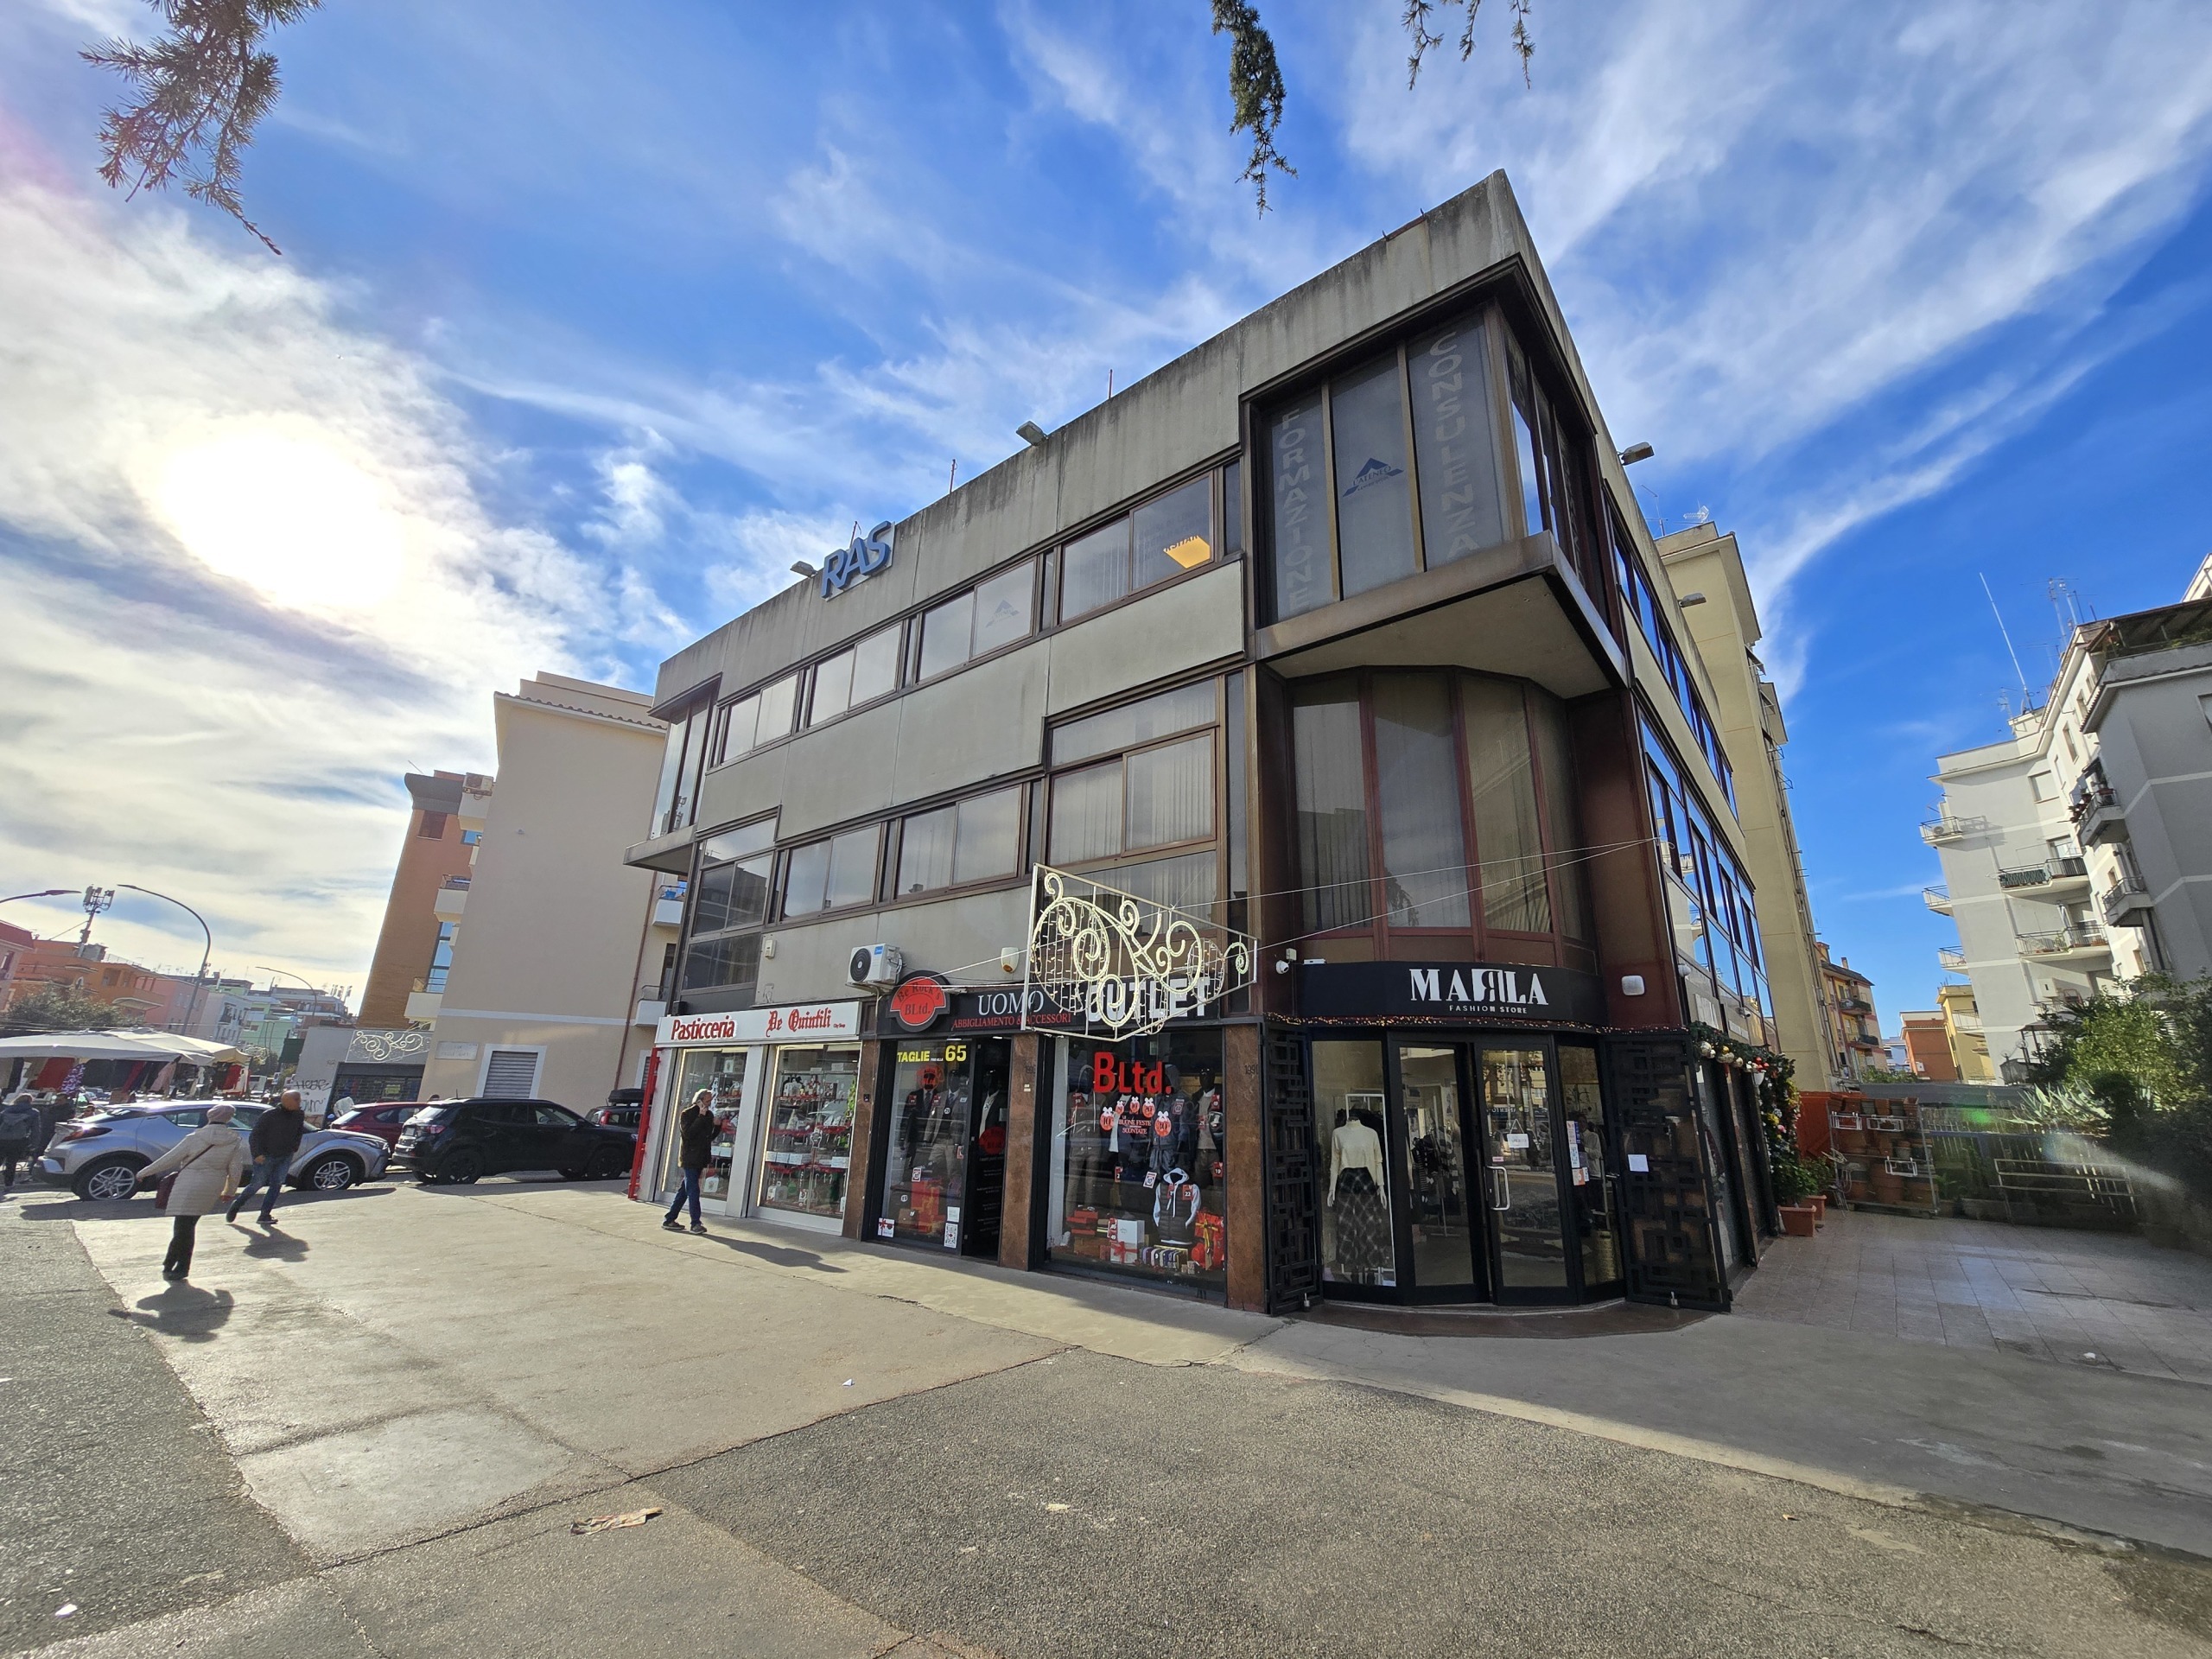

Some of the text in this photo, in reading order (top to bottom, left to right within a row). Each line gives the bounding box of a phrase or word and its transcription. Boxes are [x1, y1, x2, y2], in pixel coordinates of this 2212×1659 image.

[1429, 332, 1480, 562] CONSULENZA
[1279, 409, 1313, 612] FORMAZIONE
[821, 520, 892, 598] RAS
[977, 990, 1045, 1015] UOMO
[1087, 976, 1211, 1022] OUTLET
[671, 1014, 735, 1040] Pasticceria
[952, 1016, 1015, 1028] ABBIGLIAMENTO
[1025, 1013, 1071, 1025] ACCESSORI
[897, 1050, 931, 1063] TAGLIE
[944, 1045, 967, 1062] 65
[1094, 1052, 1173, 1094] BLtd.
